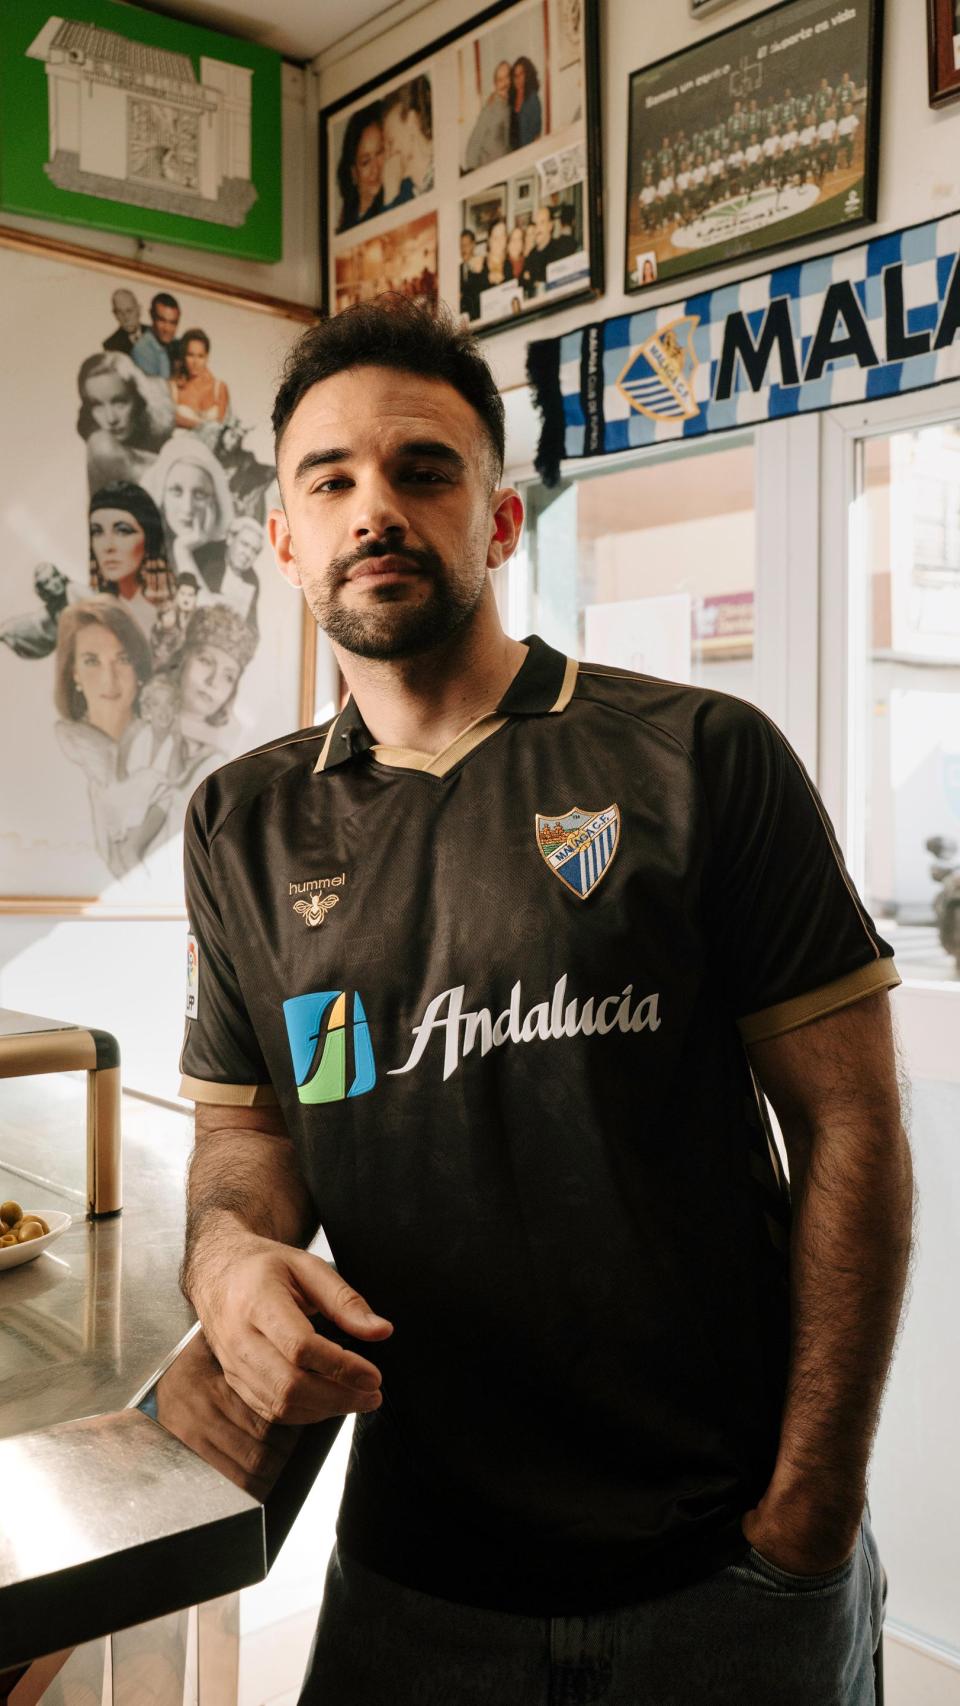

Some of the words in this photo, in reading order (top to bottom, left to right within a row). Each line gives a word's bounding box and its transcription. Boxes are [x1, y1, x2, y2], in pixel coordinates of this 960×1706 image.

[830, 8, 857, 26] vida
[288, 872, 346, 895] hummel
[386, 973, 662, 1082] Andalucía
